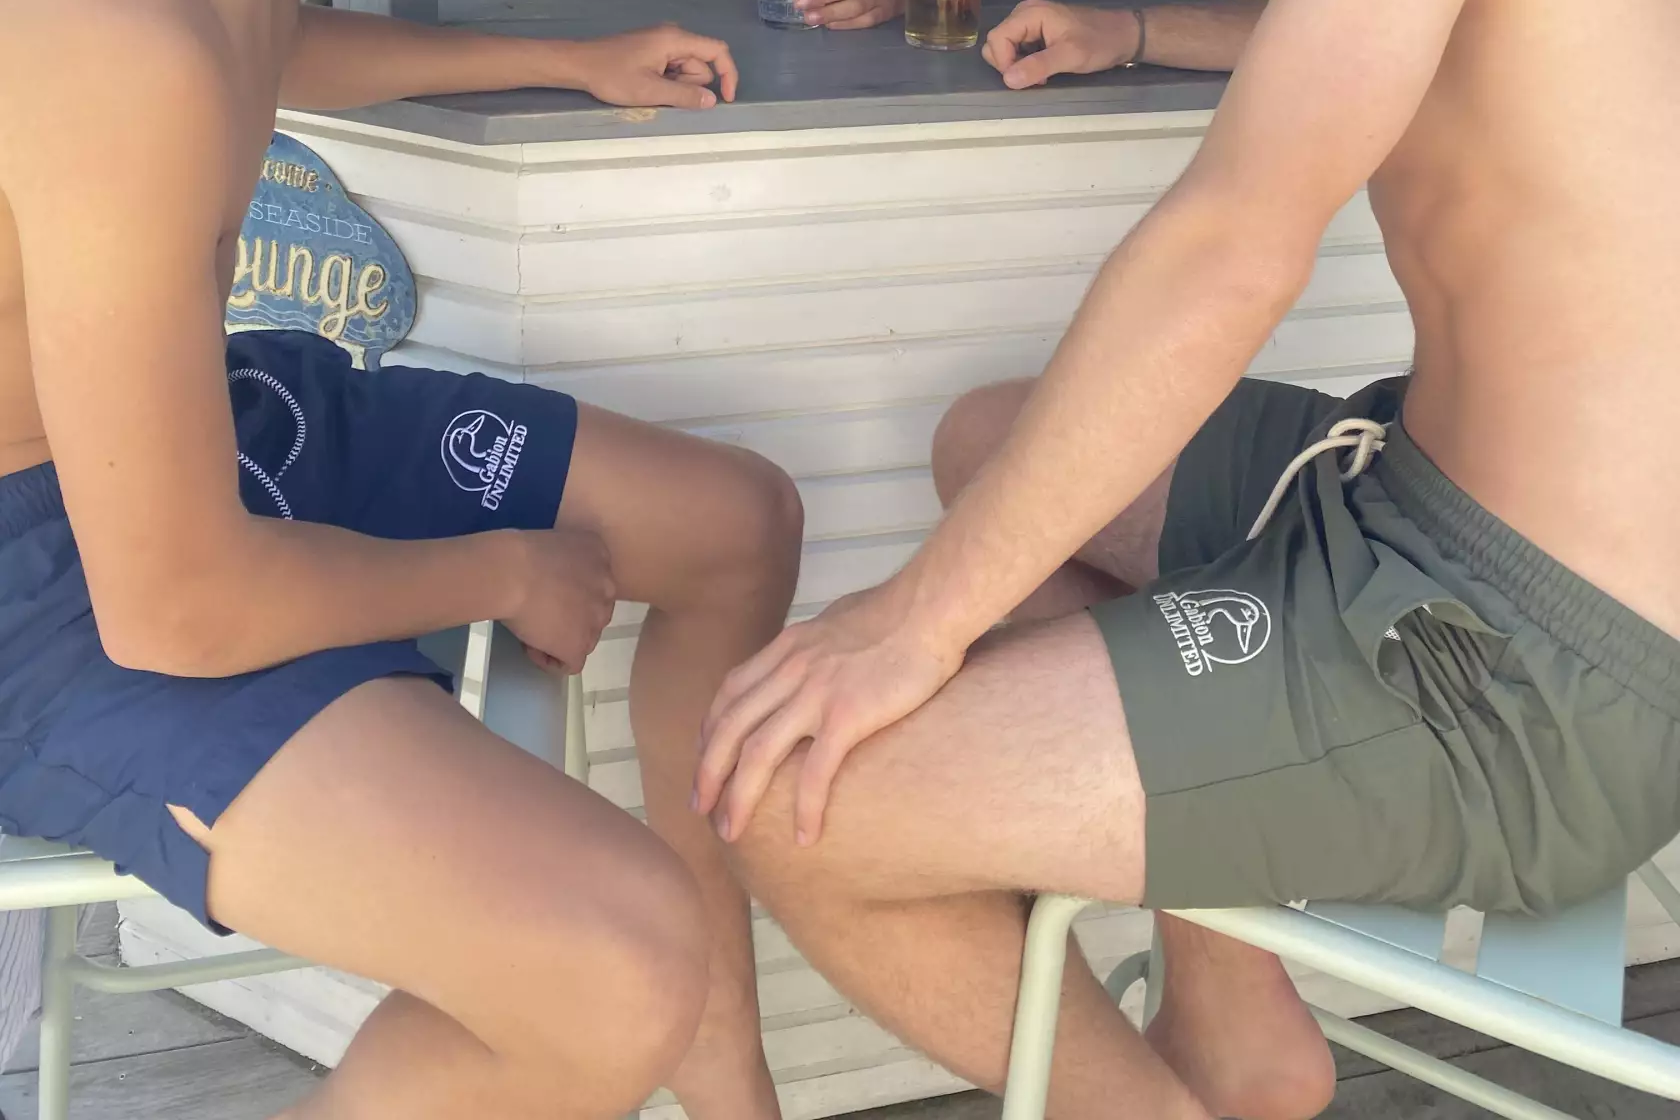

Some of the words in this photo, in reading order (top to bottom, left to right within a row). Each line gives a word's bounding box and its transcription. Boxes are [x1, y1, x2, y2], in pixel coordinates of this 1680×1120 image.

[263, 159, 320, 192] come
[249, 200, 373, 245] SEASIDE
[479, 435, 508, 483] Gabion
[483, 424, 528, 511] UNLIMITED
[1153, 592, 1204, 676] UNLIMITED
[1180, 599, 1214, 646] Gabion
